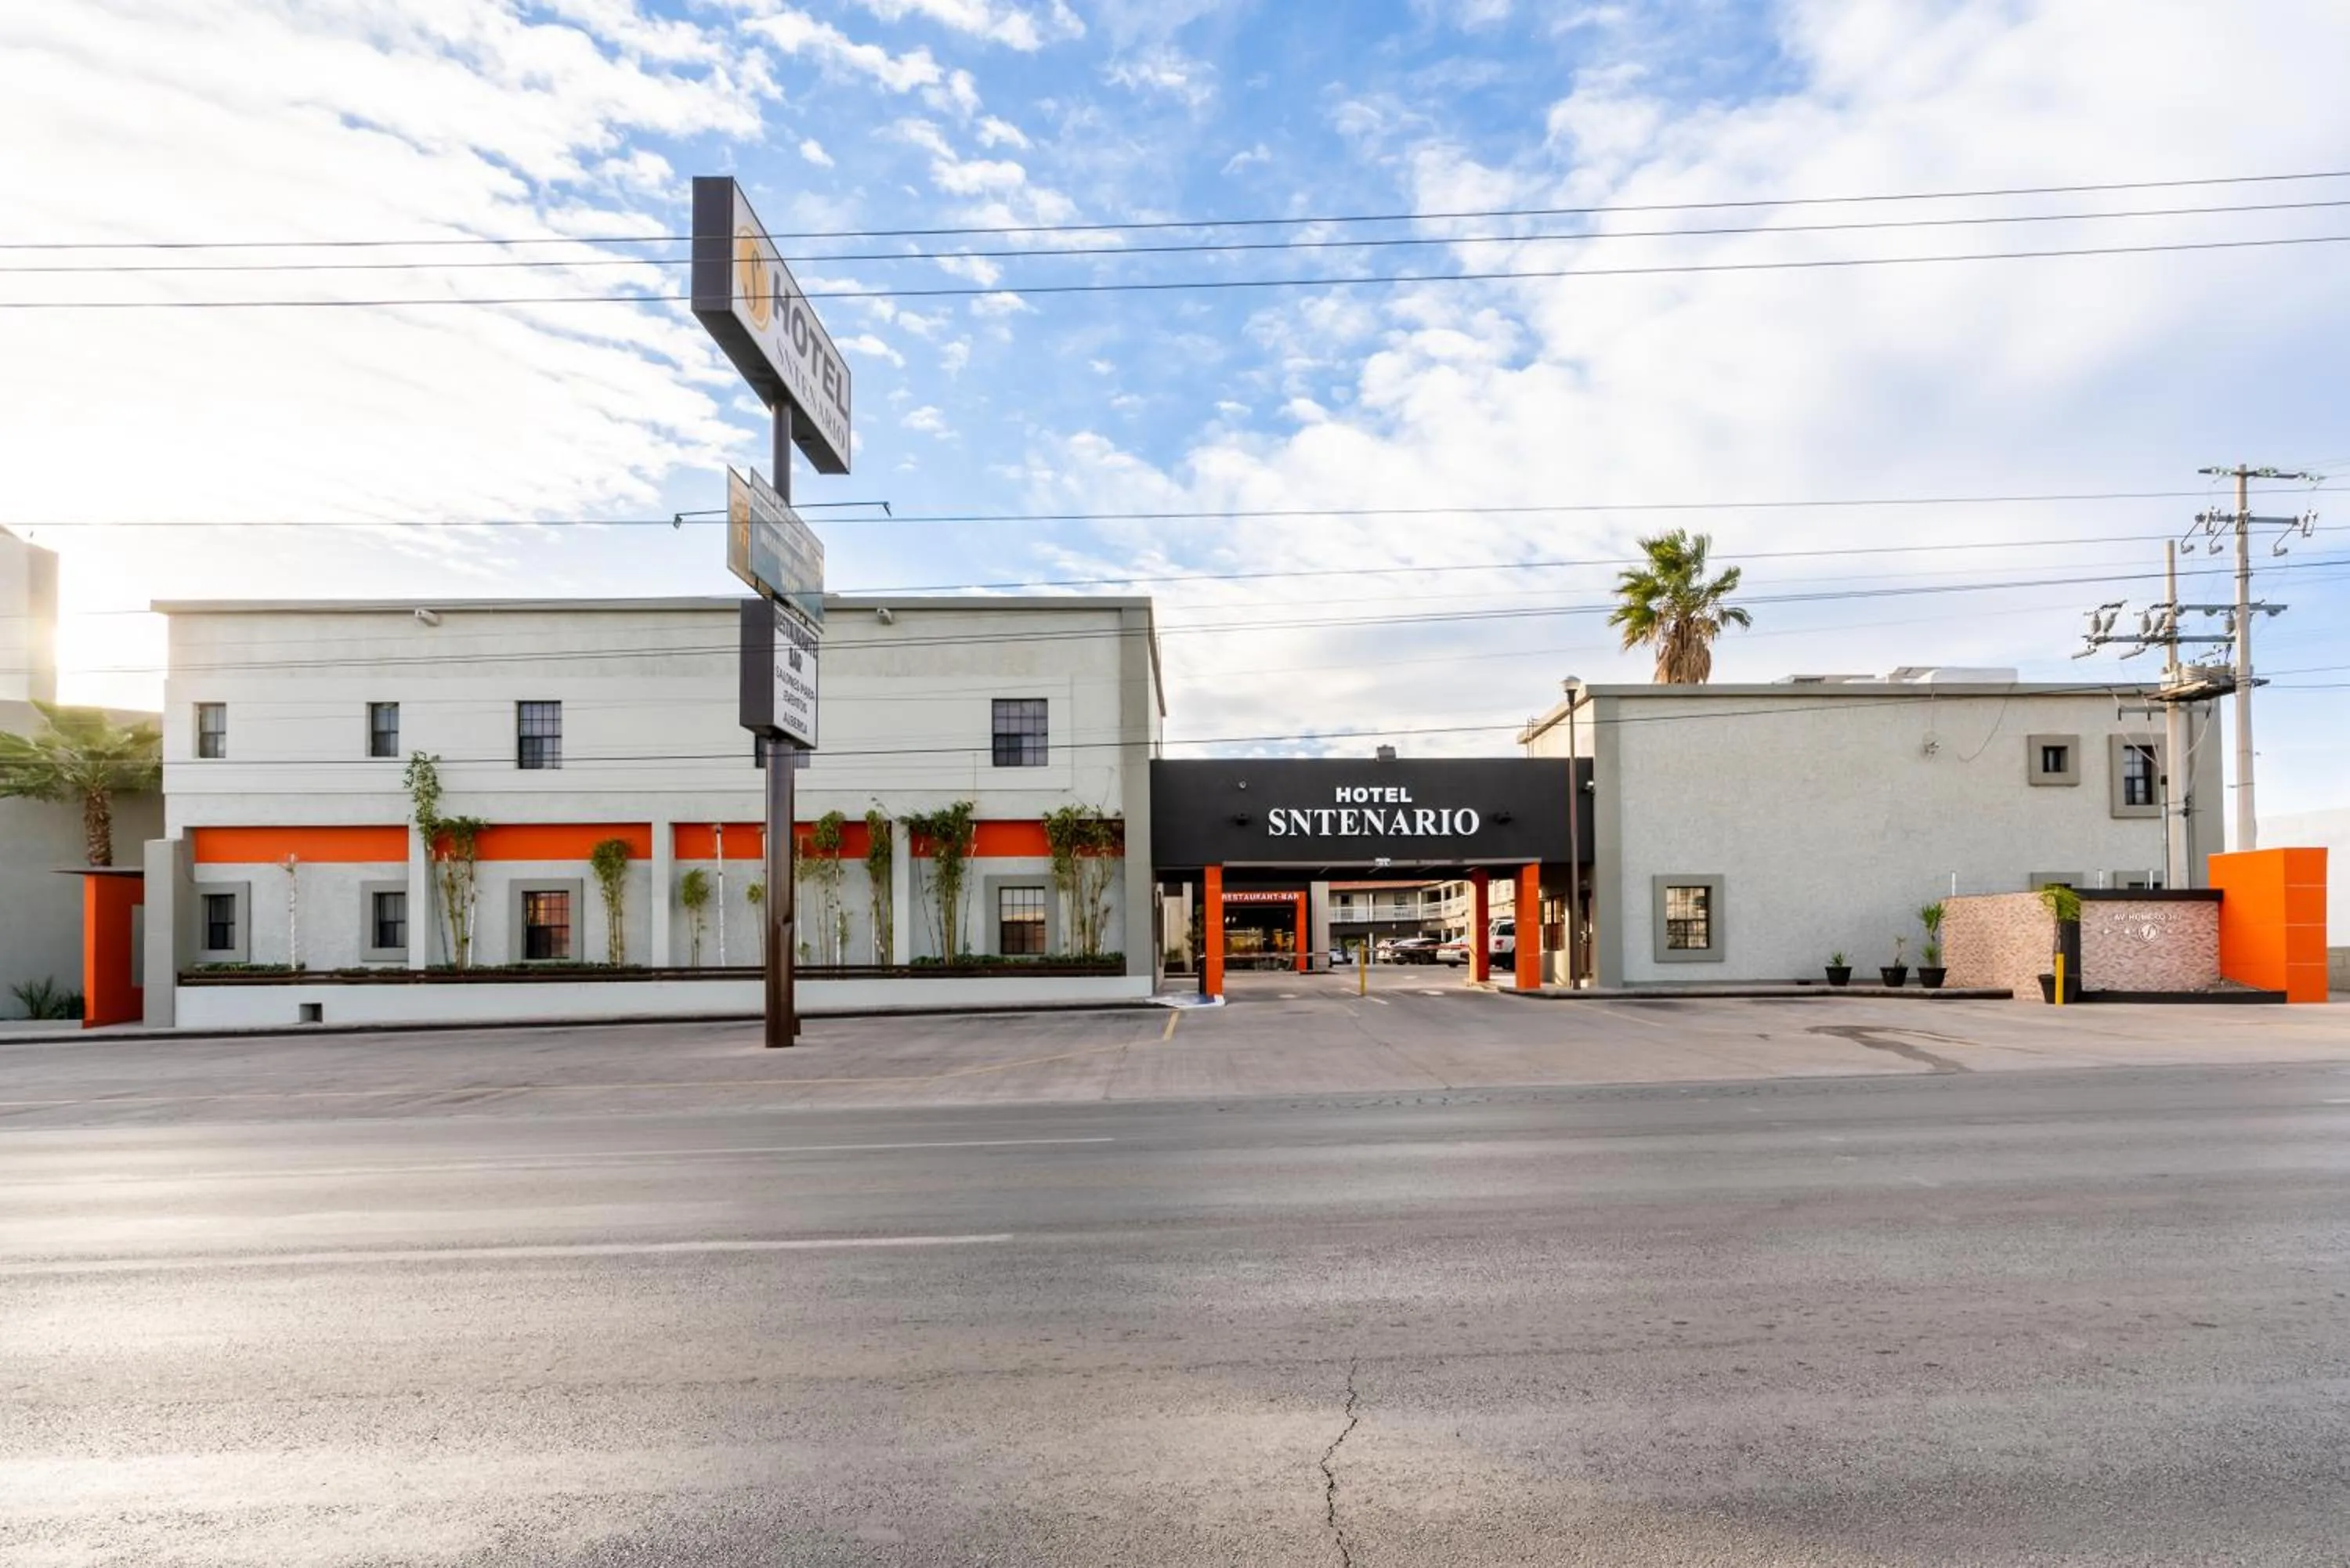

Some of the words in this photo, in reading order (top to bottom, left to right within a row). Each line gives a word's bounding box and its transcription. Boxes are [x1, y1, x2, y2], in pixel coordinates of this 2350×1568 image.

[773, 270, 848, 421] HOTEL
[1335, 786, 1413, 804] HOTEL
[1267, 807, 1480, 836] SNTENARIO
